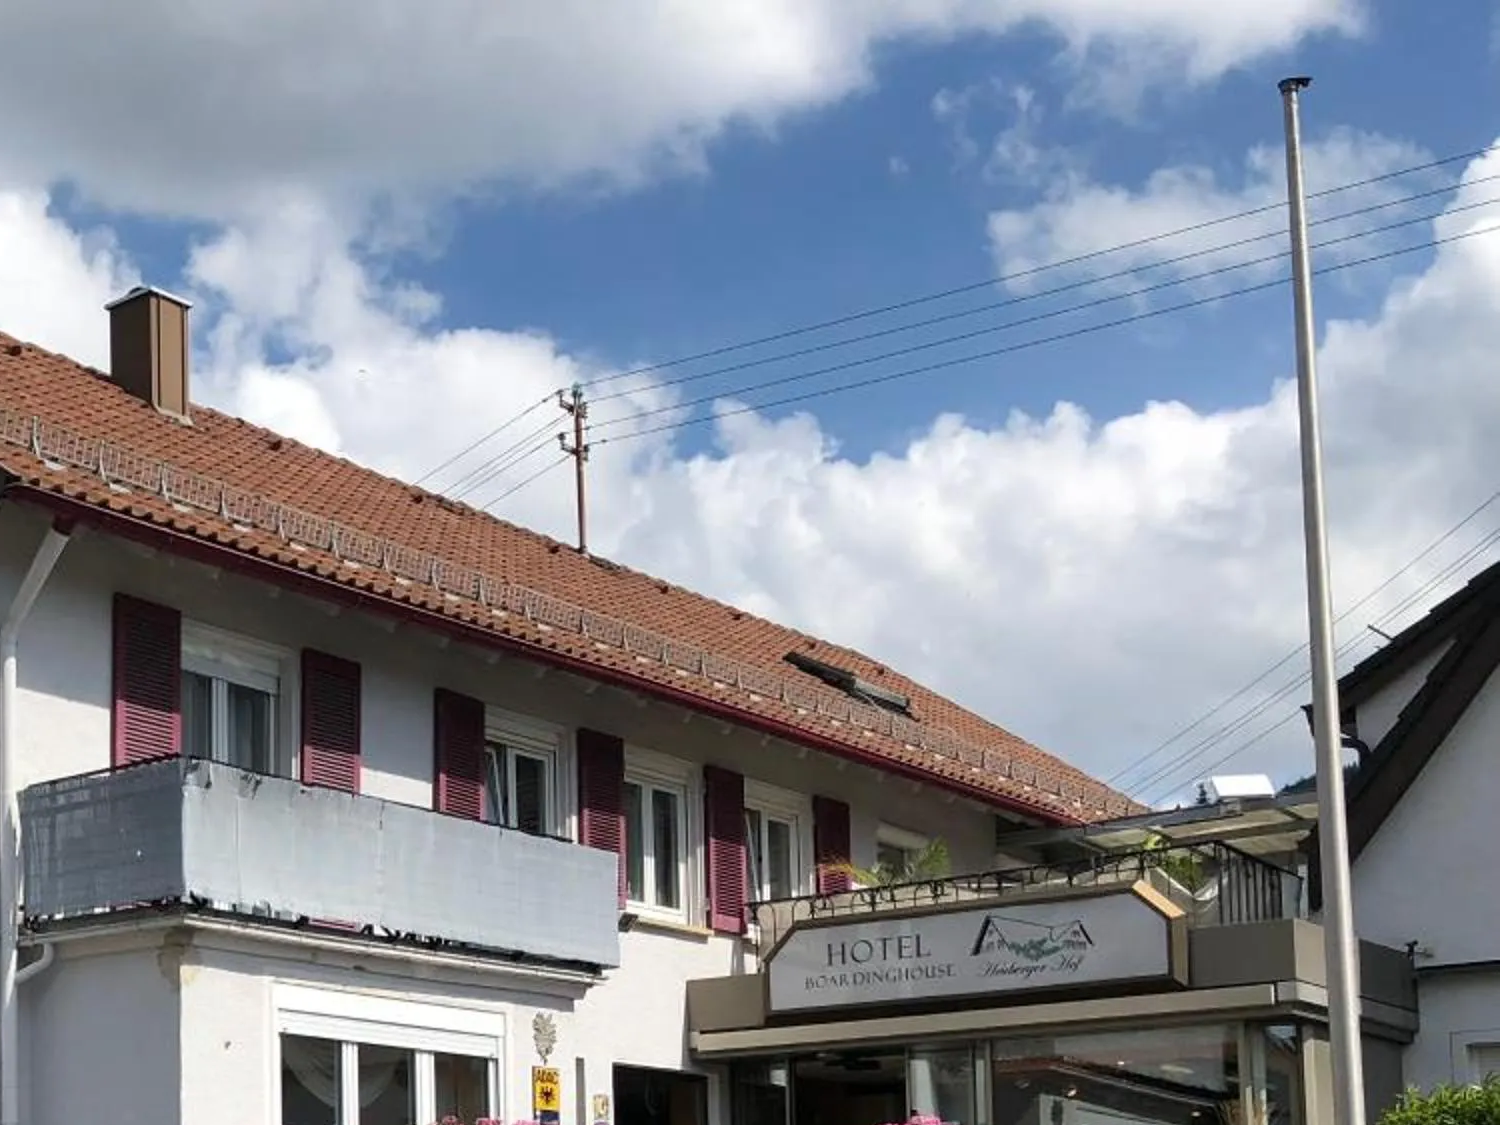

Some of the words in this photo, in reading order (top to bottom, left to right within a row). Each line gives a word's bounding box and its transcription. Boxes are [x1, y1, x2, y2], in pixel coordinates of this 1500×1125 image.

[827, 934, 932, 967] HOTEL
[1049, 953, 1085, 973] Hof
[804, 963, 957, 991] BOARDINGHOUSE
